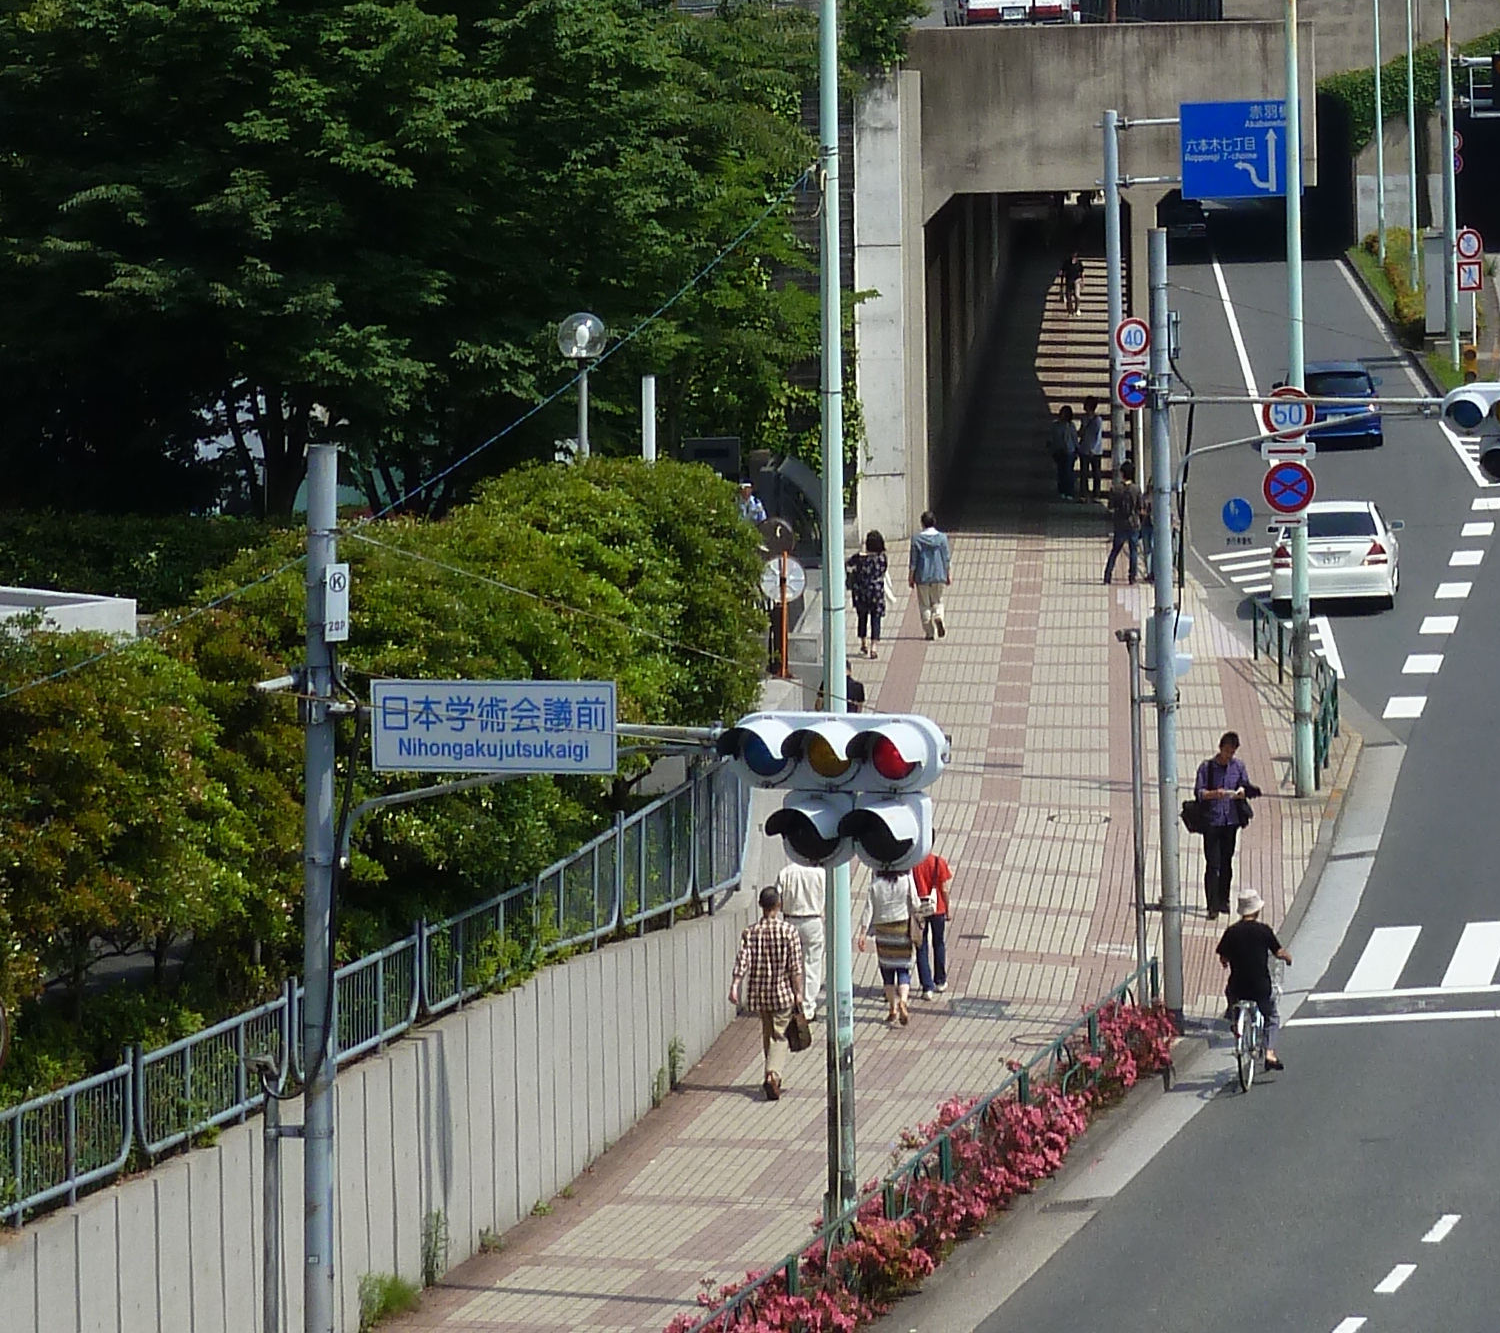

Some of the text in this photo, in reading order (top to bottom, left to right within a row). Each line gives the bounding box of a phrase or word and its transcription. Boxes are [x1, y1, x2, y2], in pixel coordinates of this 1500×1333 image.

[1186, 137, 1255, 152] 六本木七丁目
[1124, 329, 1144, 346] 40
[1274, 401, 1303, 425] 50
[382, 695, 607, 733] 日本学術会議前
[398, 738, 590, 762] Nihongakujutsukaigi
